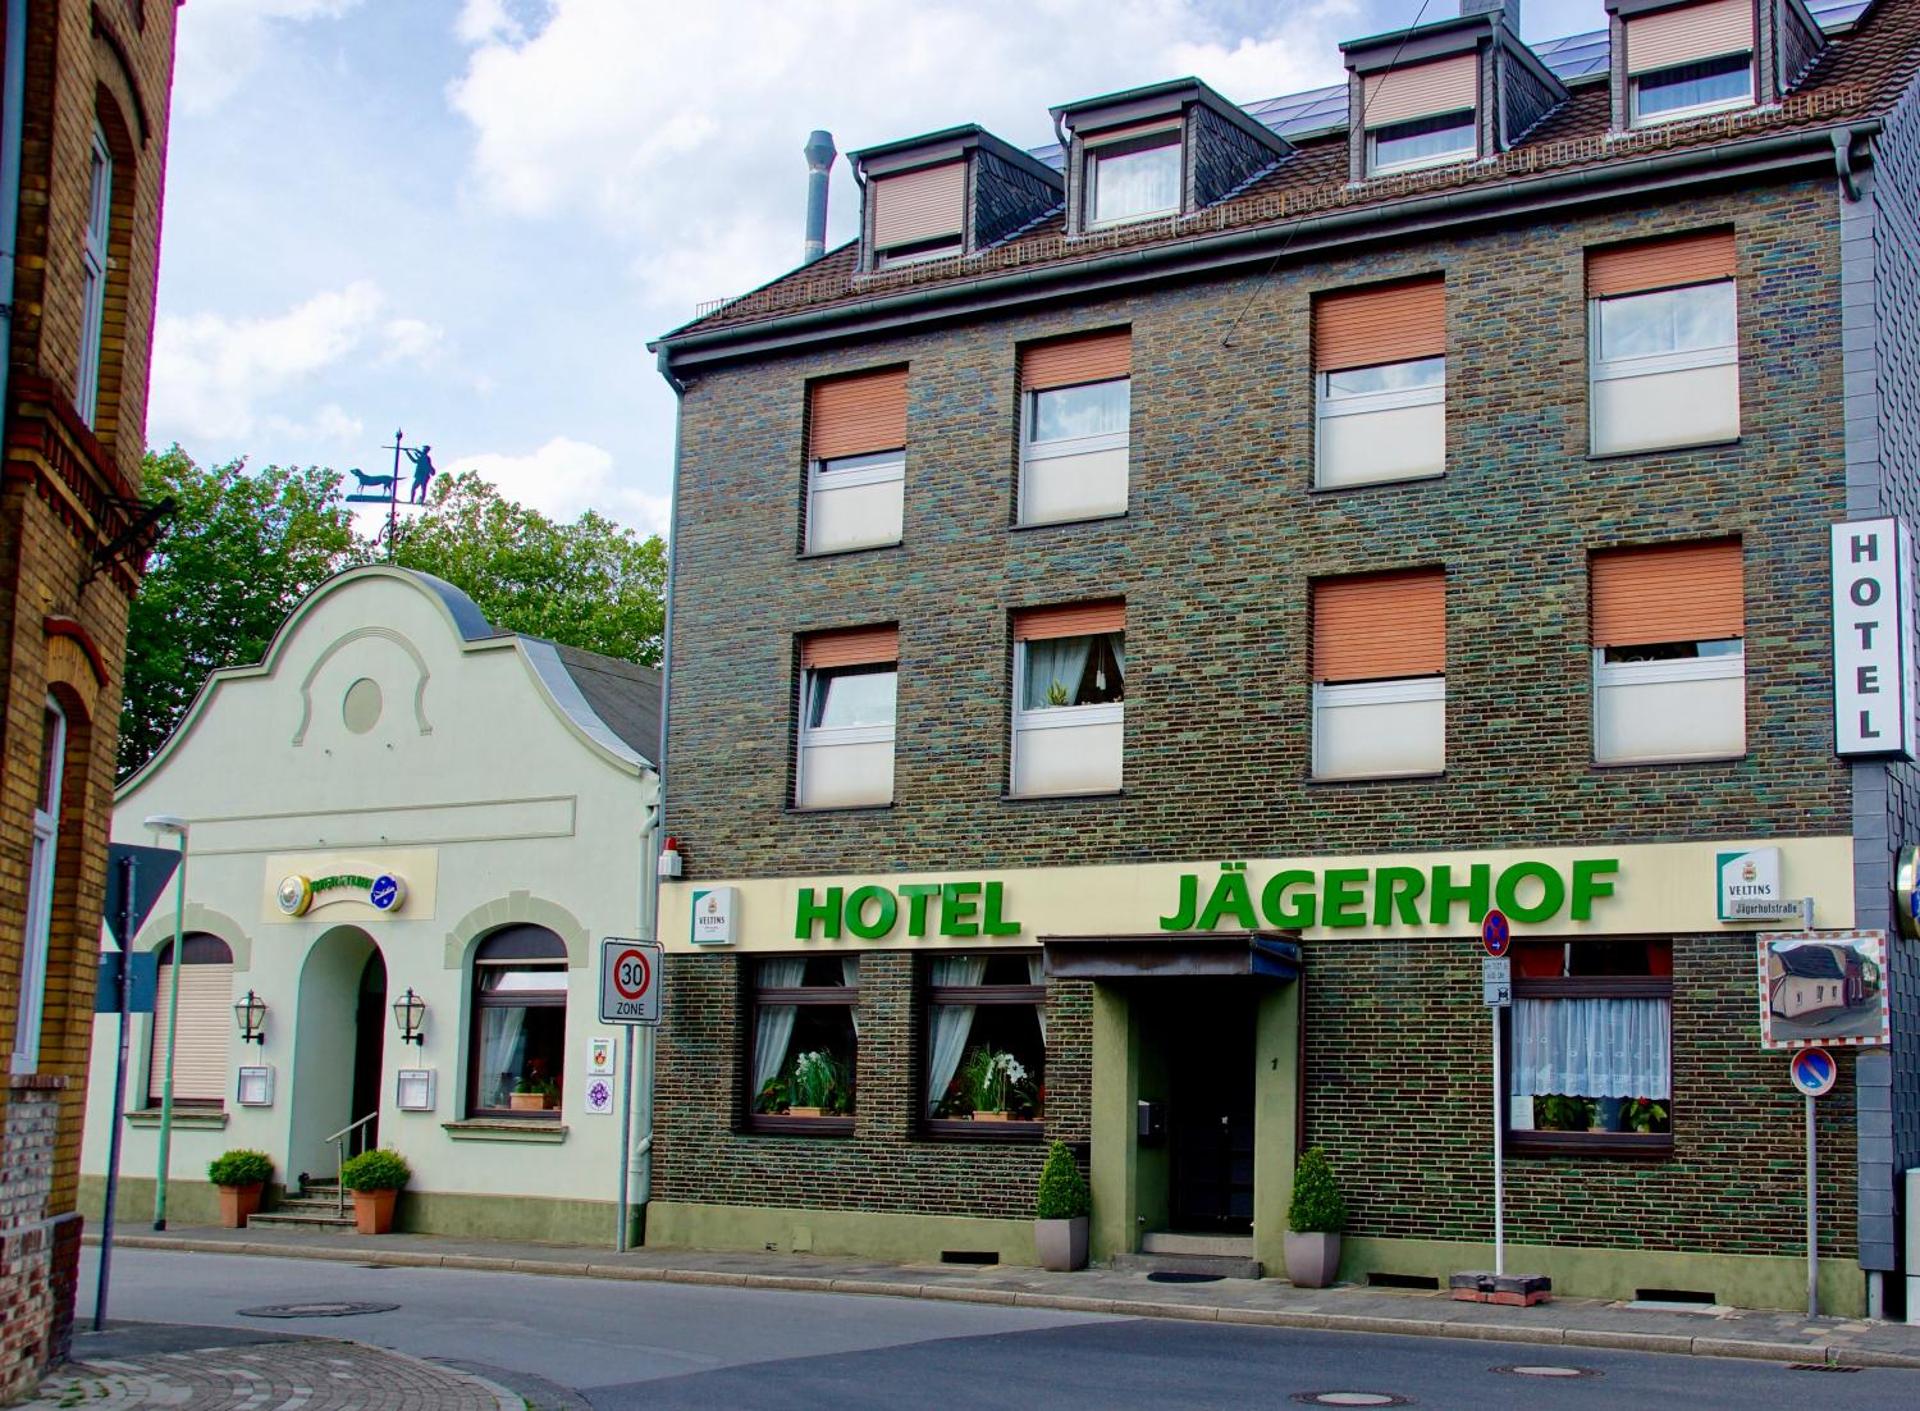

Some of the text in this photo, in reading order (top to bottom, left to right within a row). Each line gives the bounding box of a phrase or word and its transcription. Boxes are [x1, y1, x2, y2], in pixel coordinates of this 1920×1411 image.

[1850, 533, 1882, 739] HOTEL
[1159, 858, 1620, 932] JÄGERHOF
[1729, 884, 1771, 895] VELTINS
[795, 881, 1022, 940] HOTEL
[1736, 903, 1797, 915] Jägerhofstraße
[621, 963, 643, 987] 30
[617, 1002, 645, 1016] ZONE
[1271, 1057, 1279, 1071] 1
